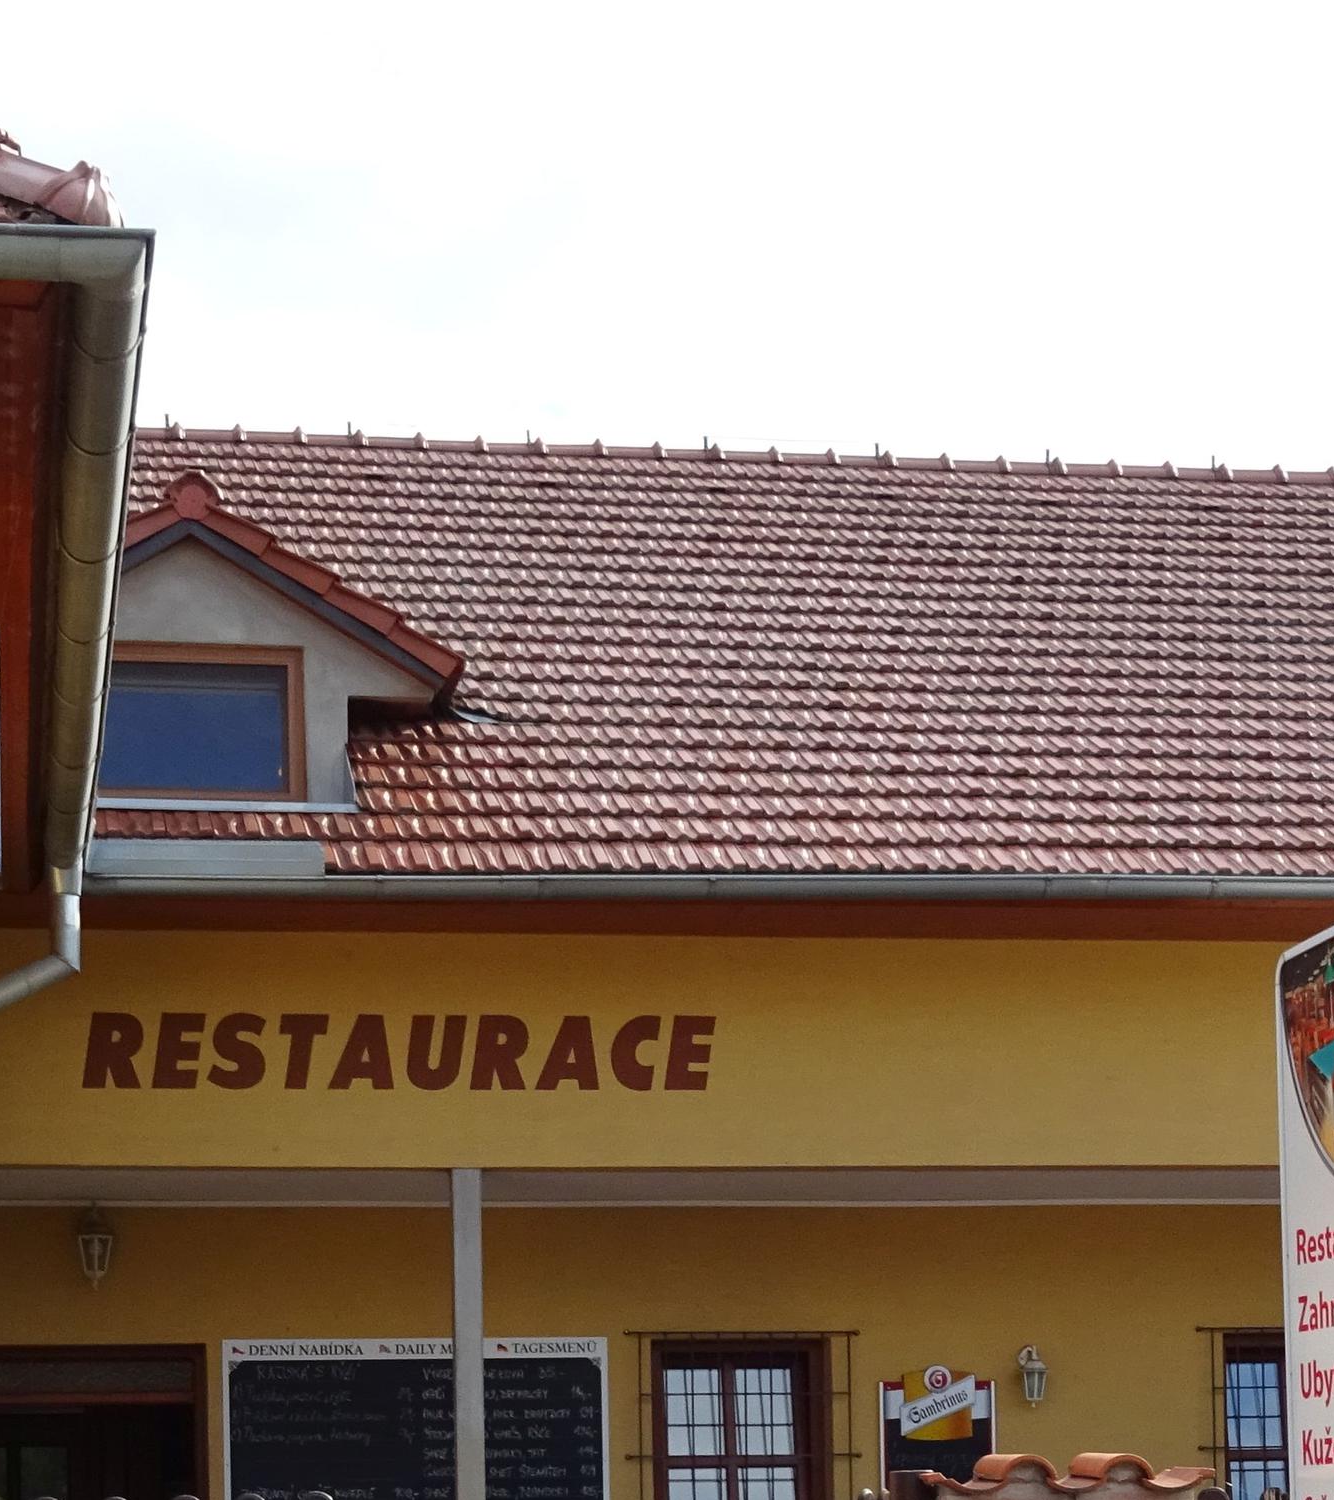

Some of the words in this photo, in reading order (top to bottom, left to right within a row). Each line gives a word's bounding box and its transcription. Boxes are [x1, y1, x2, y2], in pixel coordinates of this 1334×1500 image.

[82, 1012, 717, 1091] RESTAURACE
[249, 1341, 295, 1355] DENNÍ
[299, 1341, 364, 1355] NABÍDKA
[395, 1343, 437, 1354] DAILY
[513, 1340, 598, 1354] TAGESMENÜ
[908, 1390, 968, 1423] Gambrinus
